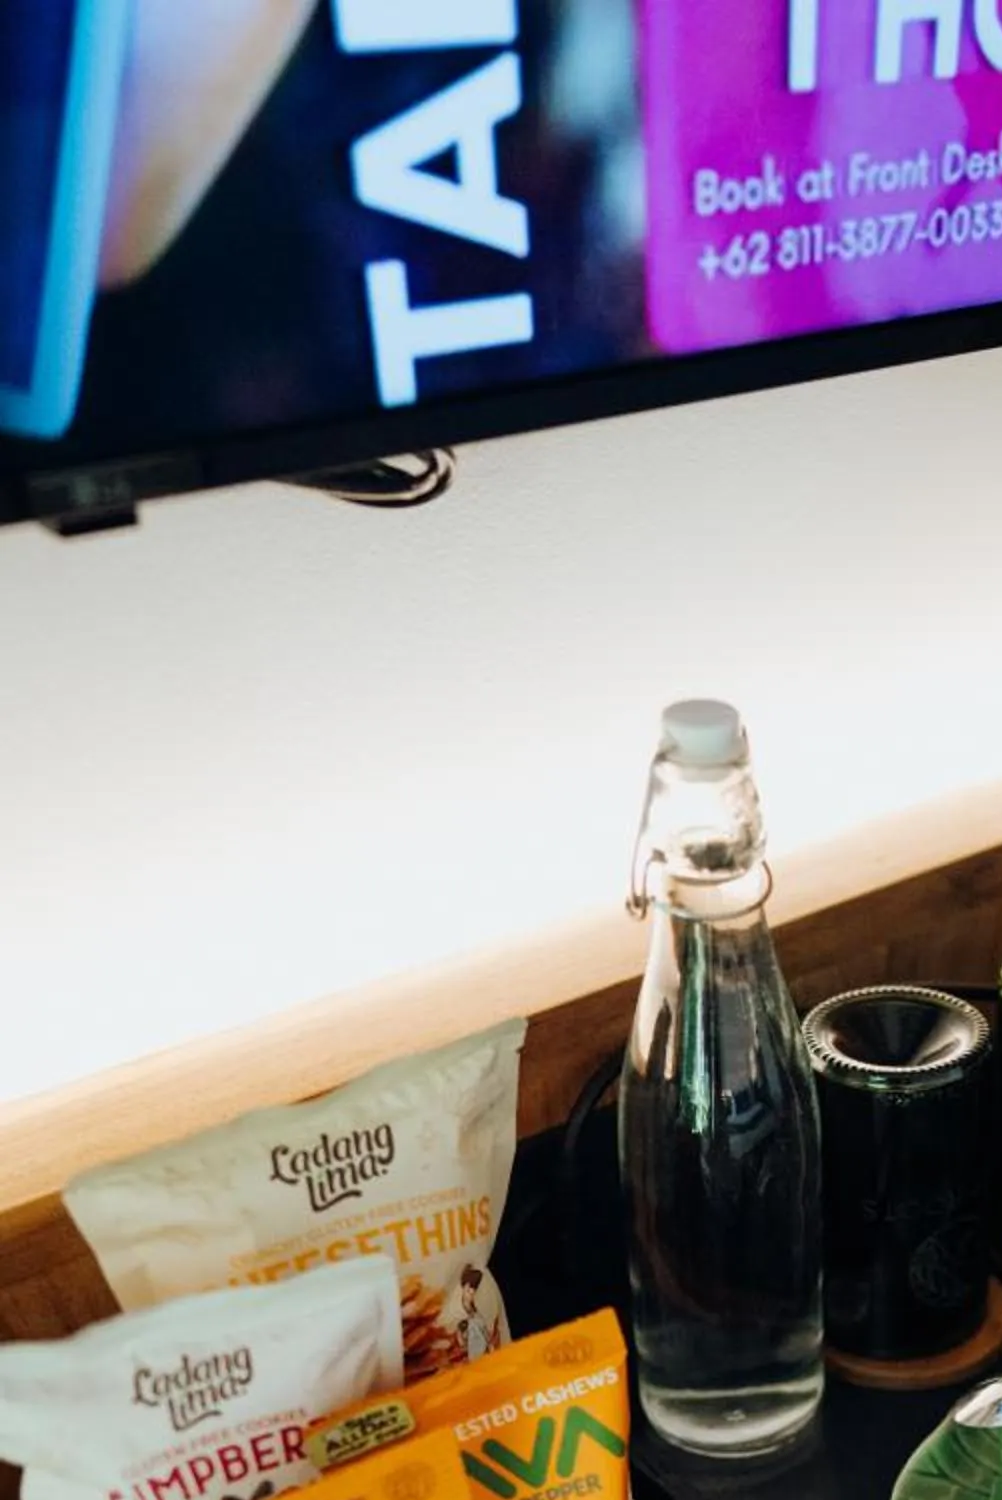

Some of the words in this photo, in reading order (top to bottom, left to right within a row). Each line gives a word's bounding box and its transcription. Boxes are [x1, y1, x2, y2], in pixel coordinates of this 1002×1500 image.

[332, 0, 534, 409] TA
[694, 154, 782, 216] Book
[797, 165, 832, 201] at
[847, 152, 929, 196] Front
[698, 232, 769, 281] +62
[270, 1123, 396, 1186] Ladang
[133, 1347, 254, 1407] Ladang
[521, 1366, 620, 1415] CASHEWS
